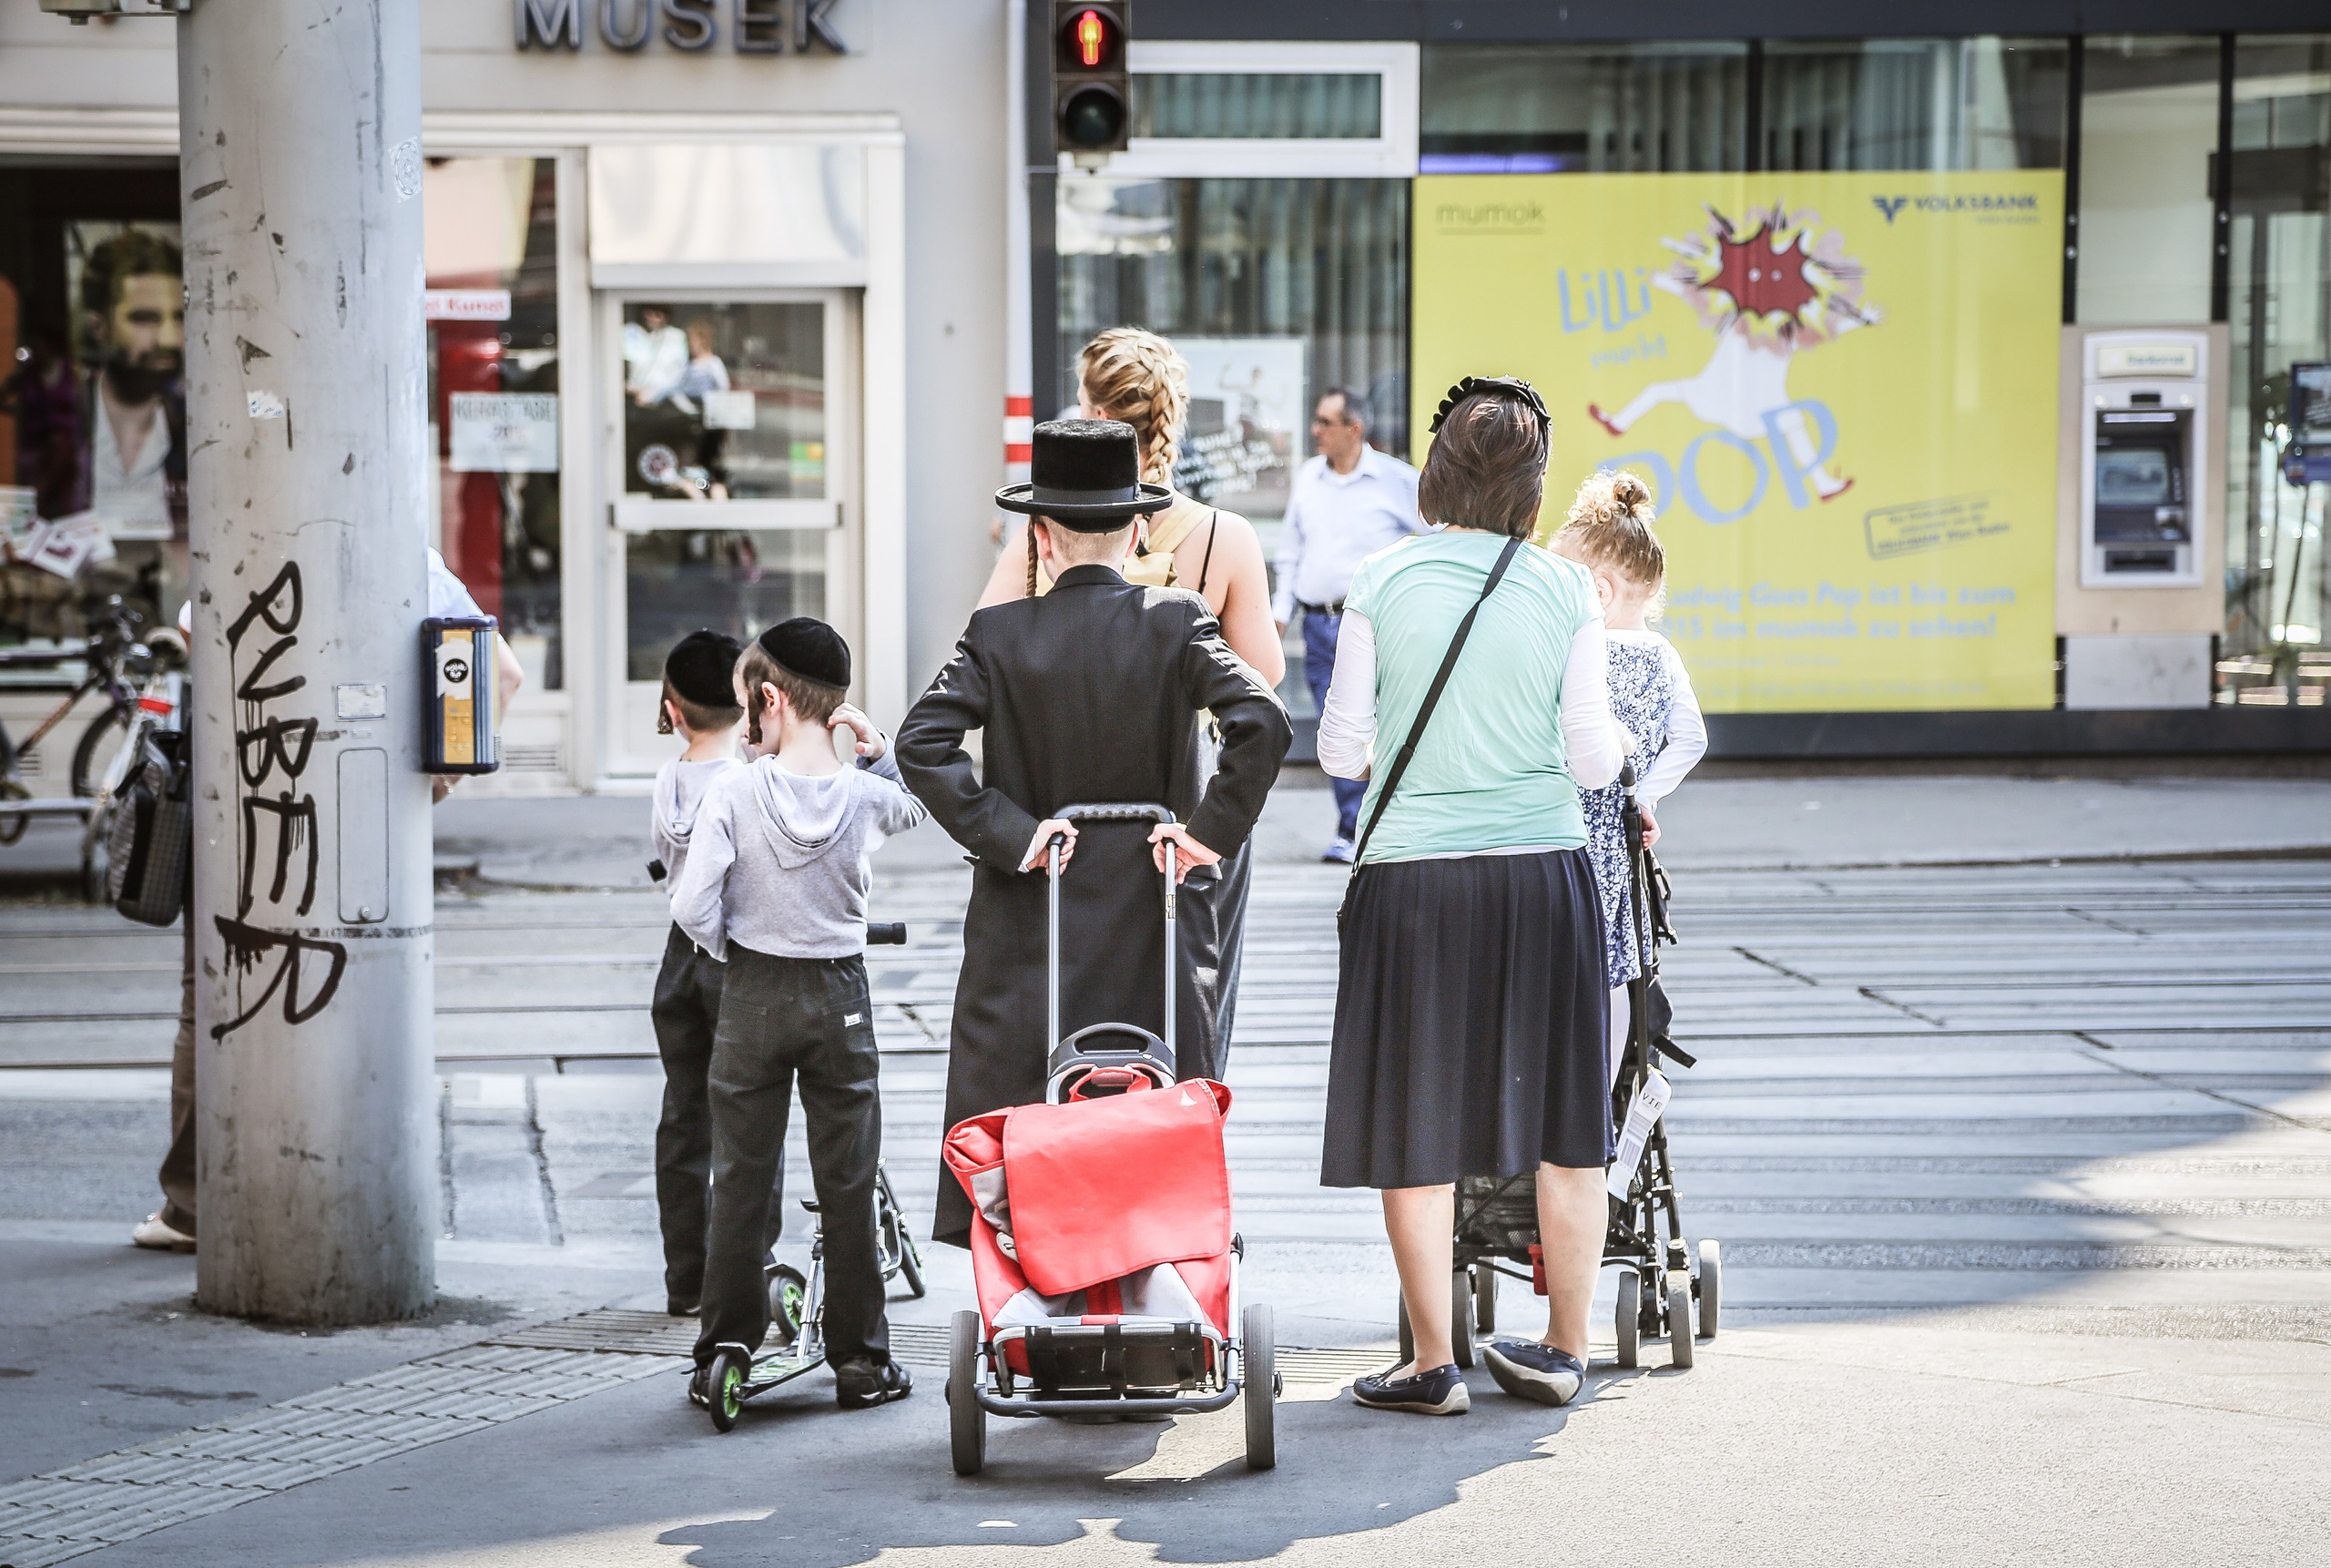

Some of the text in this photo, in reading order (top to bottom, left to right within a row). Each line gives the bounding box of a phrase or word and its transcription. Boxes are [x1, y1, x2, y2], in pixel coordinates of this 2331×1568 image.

[1435, 199, 1545, 226] mumok
[1914, 194, 2037, 210] VOLKSBANK
[1749, 581, 1809, 607] Goes
[1817, 581, 1862, 614] Pop
[1869, 582, 1902, 606] ist
[1909, 581, 1948, 606] bis
[1957, 585, 2015, 606] zum
[1714, 616, 1747, 639] im
[1756, 613, 1859, 639] mumok
[1868, 620, 1900, 638] zu
[1909, 612, 1997, 638] sehen!
[1642, 1093, 1663, 1111] VIE
